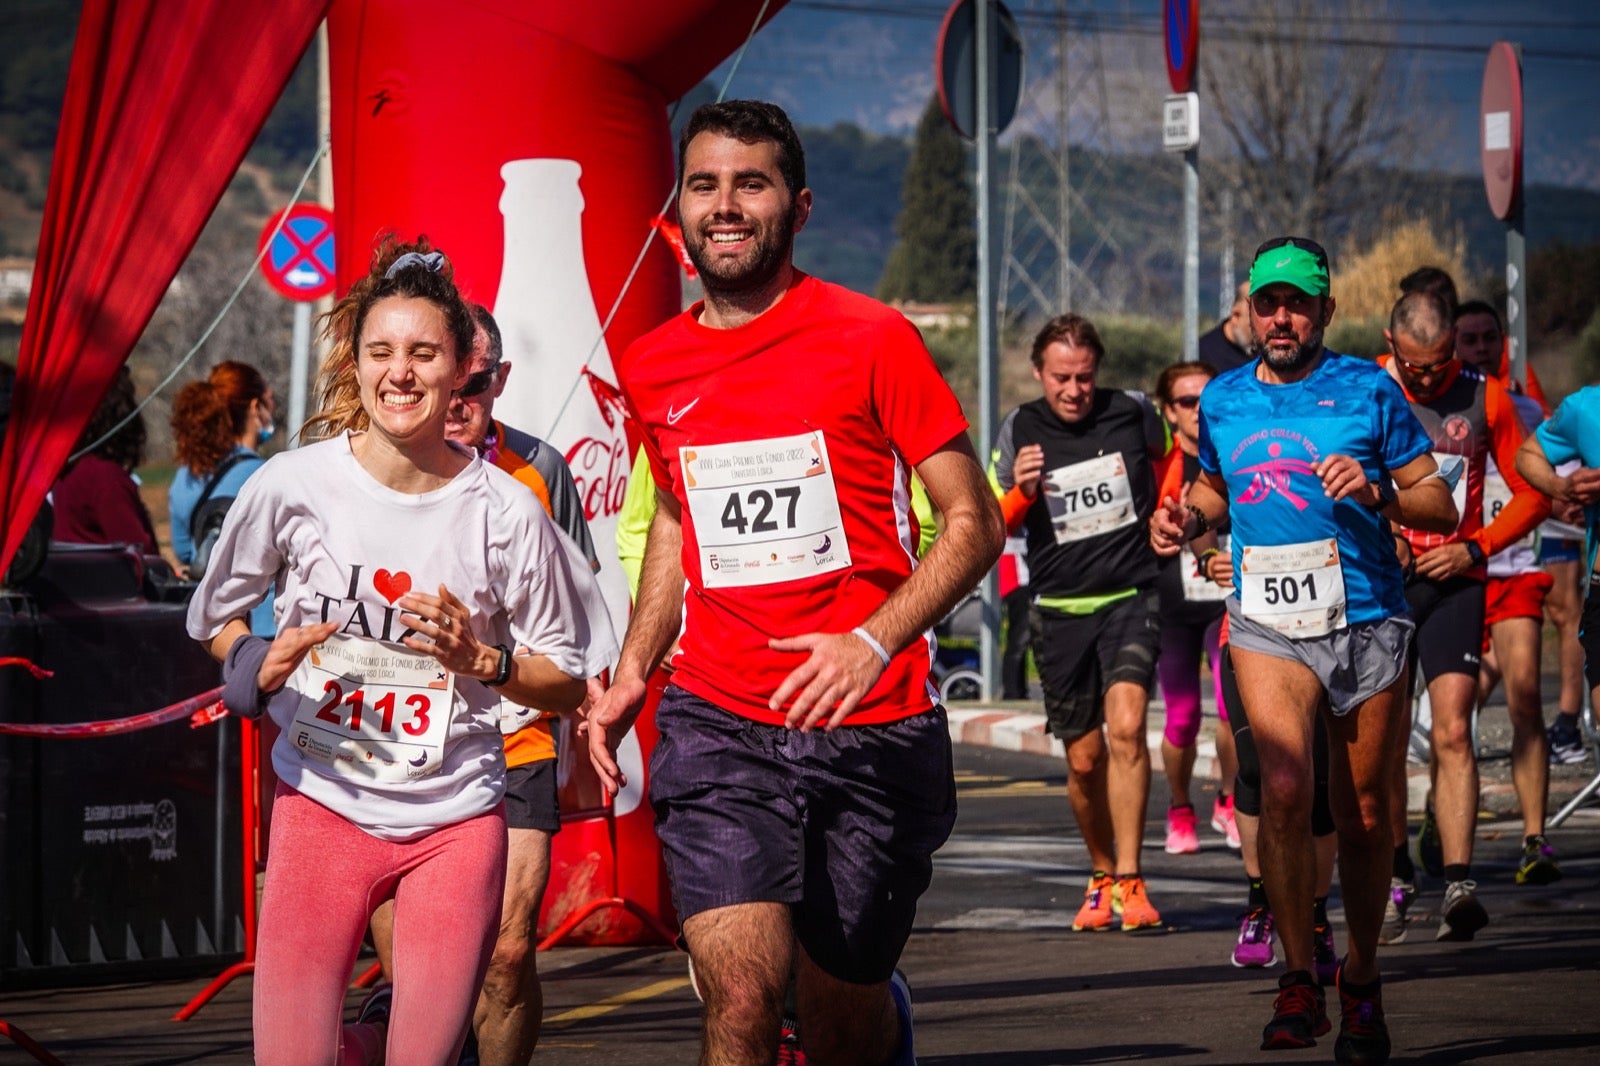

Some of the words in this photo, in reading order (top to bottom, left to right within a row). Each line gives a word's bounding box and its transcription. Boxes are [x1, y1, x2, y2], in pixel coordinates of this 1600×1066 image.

[733, 454, 756, 468] PREMIO
[765, 451, 786, 464] FONDO
[785, 447, 805, 462] 2022
[720, 485, 802, 535] 427
[1064, 482, 1114, 513] 766
[814, 555, 835, 566] Lorca
[346, 564, 364, 601] I
[1264, 572, 1318, 606] 501
[355, 654, 380, 668] PREMIO
[380, 657, 389, 668] DE
[389, 656, 413, 671] FONDO
[414, 660, 435, 671] 2022
[378, 668, 397, 679] LORCA
[314, 679, 432, 737] 2113
